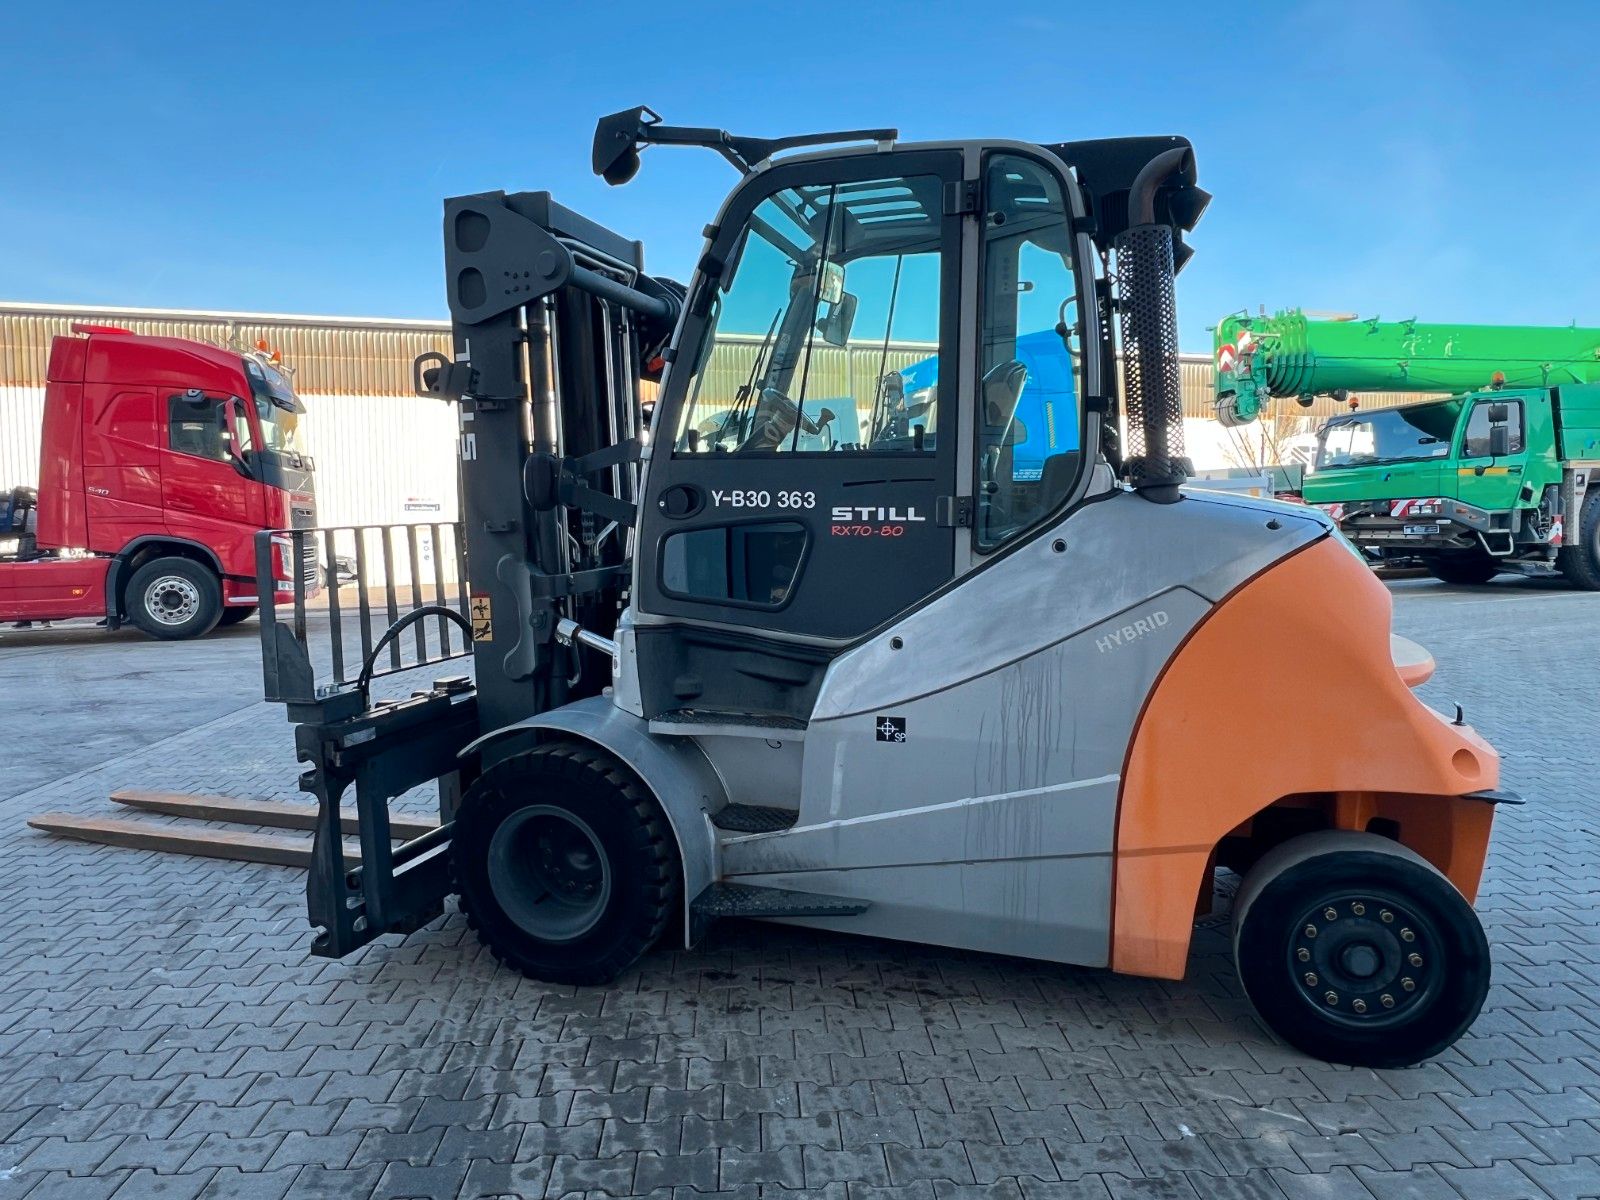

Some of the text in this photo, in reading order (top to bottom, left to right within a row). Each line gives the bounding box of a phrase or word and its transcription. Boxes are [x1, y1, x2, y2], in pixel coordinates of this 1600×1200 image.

[711, 490, 816, 509] Y-B30 363
[831, 506, 926, 521] STILL
[1095, 611, 1169, 653] HYBRID
